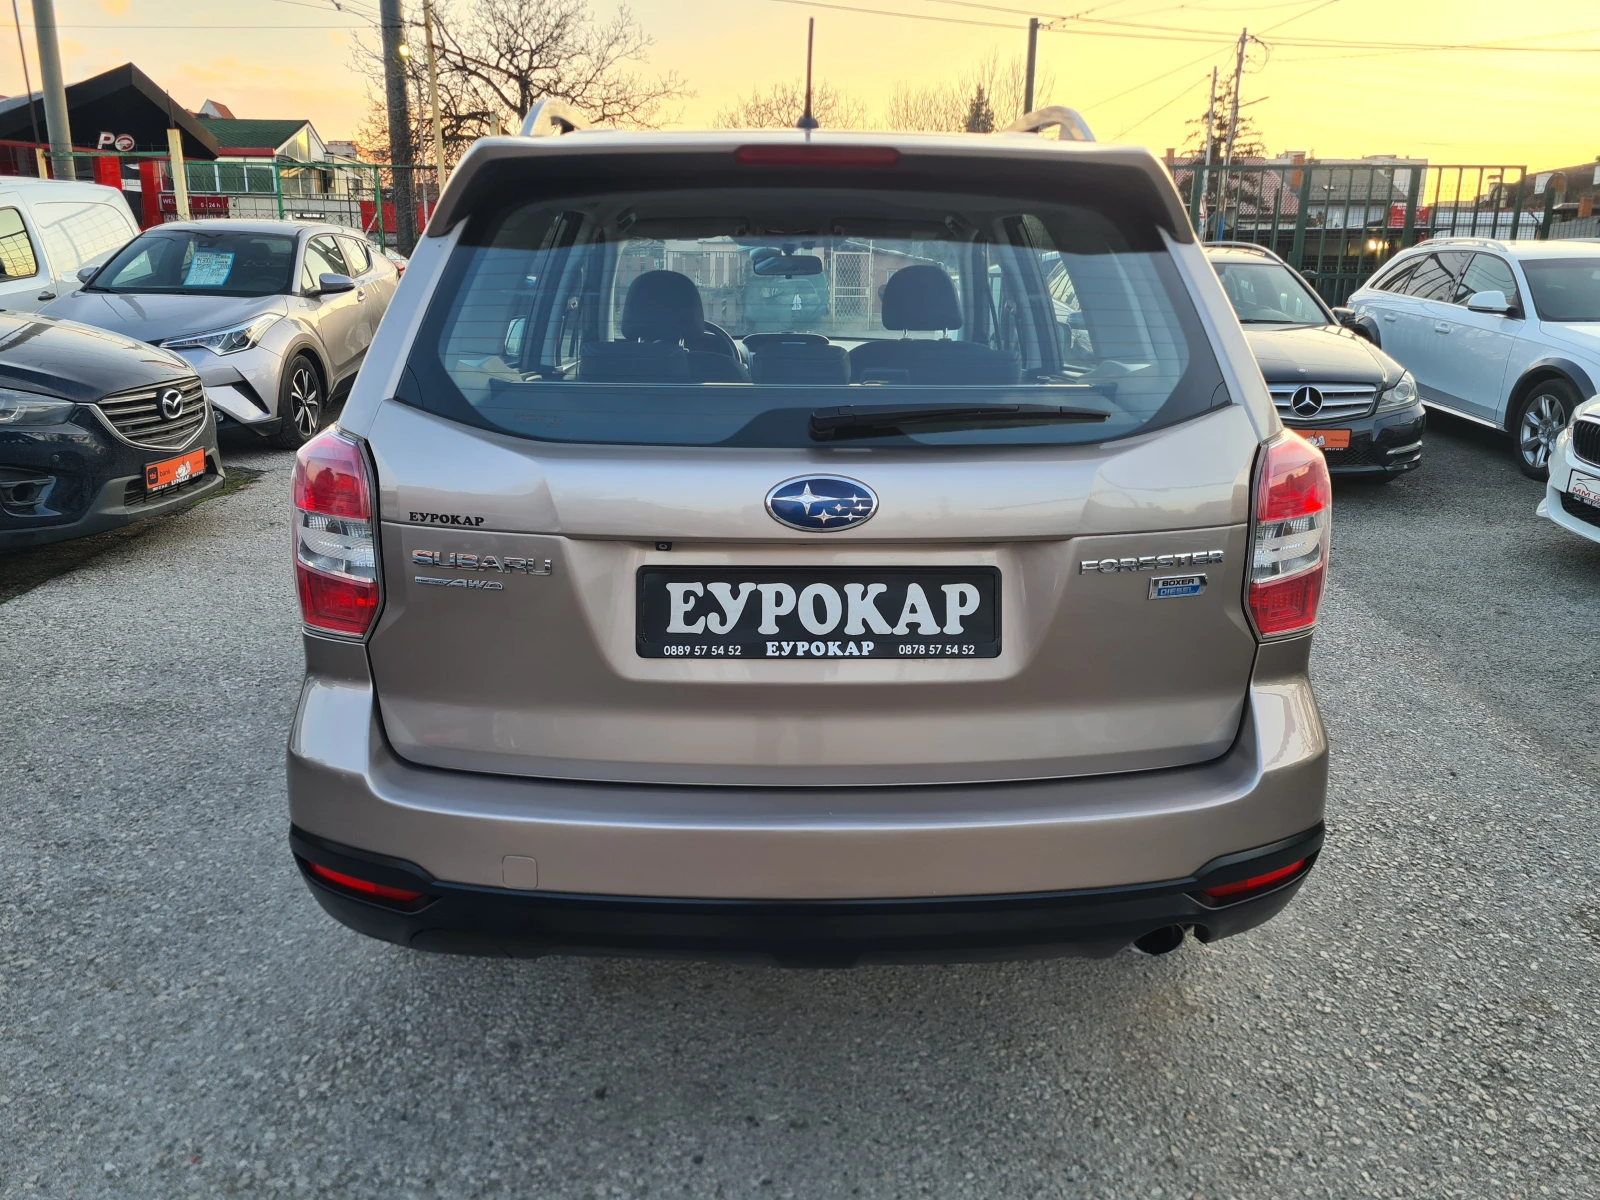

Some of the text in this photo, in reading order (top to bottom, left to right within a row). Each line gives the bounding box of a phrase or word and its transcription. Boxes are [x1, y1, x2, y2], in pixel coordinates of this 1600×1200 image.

[409, 511, 485, 526] ЕУРОКАР
[412, 549, 553, 576] SUBARU
[1079, 549, 1224, 575] FORESTER
[447, 578, 504, 590] AWD
[1161, 578, 1195, 587] BOXER
[1159, 586, 1194, 596] DIESEL
[665, 581, 981, 635] ЕУРОКАР
[663, 644, 742, 656] 0889 57 54 52
[765, 640, 875, 657] ЕУРОКАР
[898, 643, 975, 656] 0878 57 54 52
